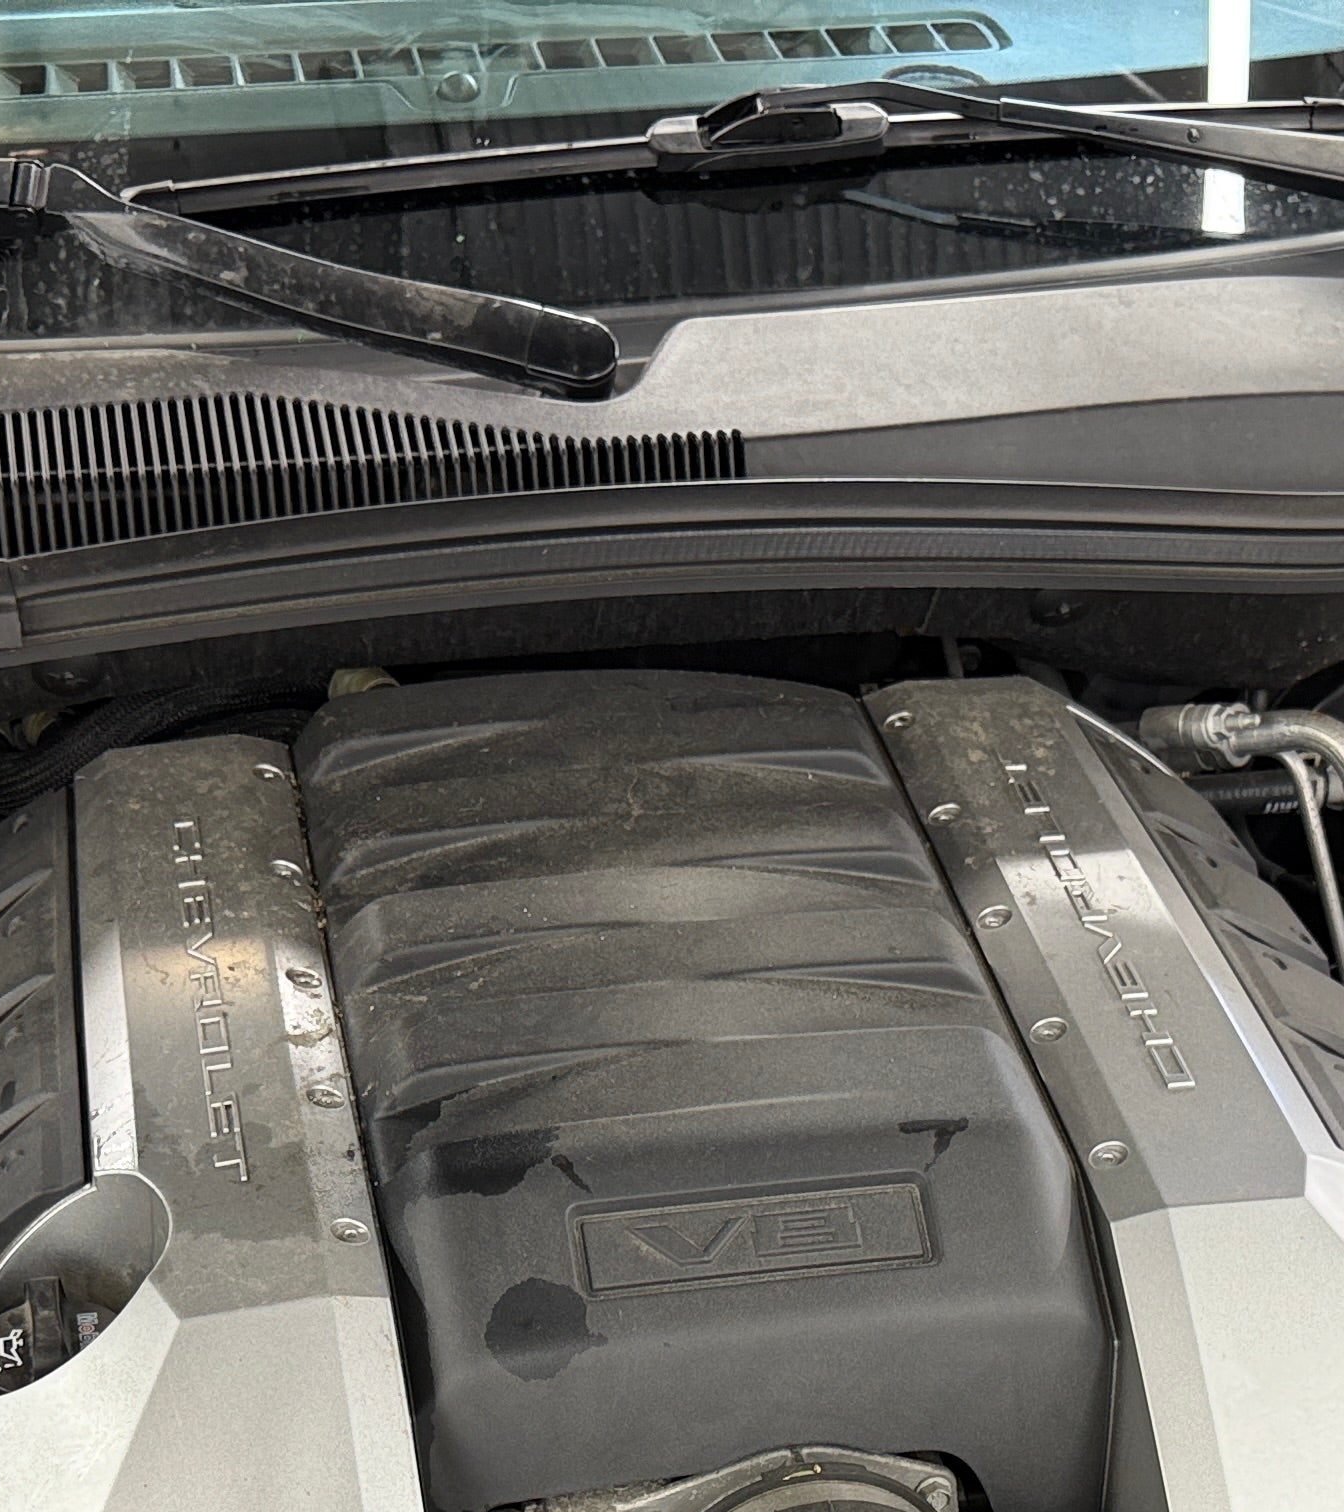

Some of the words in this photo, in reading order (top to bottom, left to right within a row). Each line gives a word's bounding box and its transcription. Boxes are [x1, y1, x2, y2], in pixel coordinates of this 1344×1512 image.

[173, 817, 249, 1182] CHEVROLET
[993, 748, 1195, 1089] CHEVROLET
[623, 1200, 863, 1269] V8
